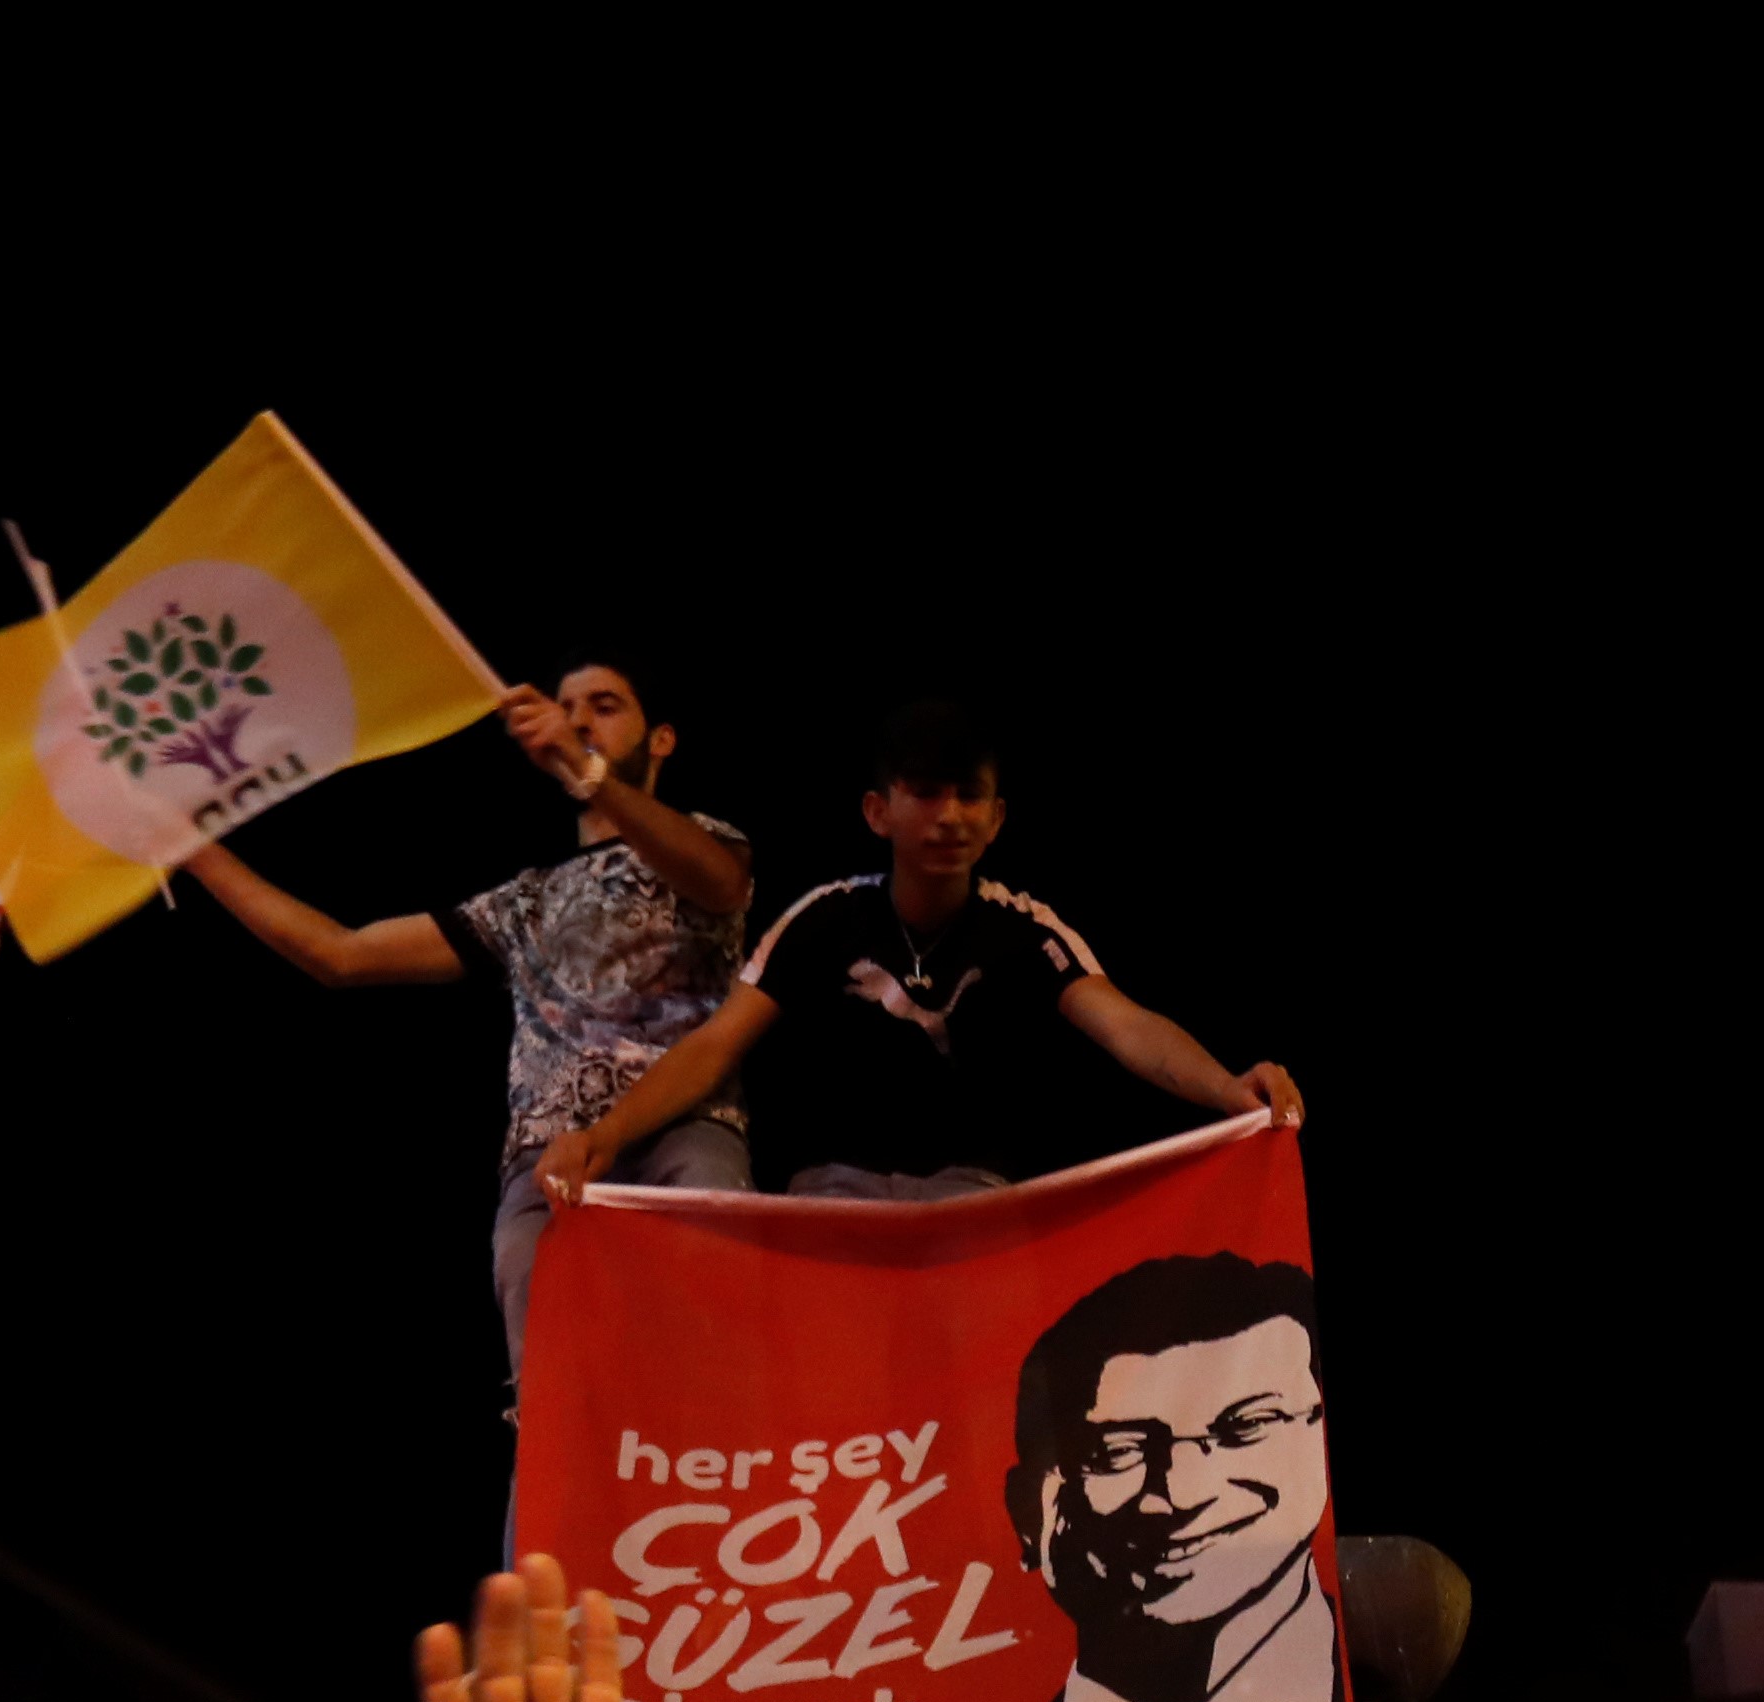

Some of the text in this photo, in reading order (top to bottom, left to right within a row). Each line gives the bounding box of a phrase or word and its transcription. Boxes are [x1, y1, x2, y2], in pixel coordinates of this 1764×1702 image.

[616, 1420, 940, 1494] her şey
[611, 1472, 949, 1597] ÇOK
